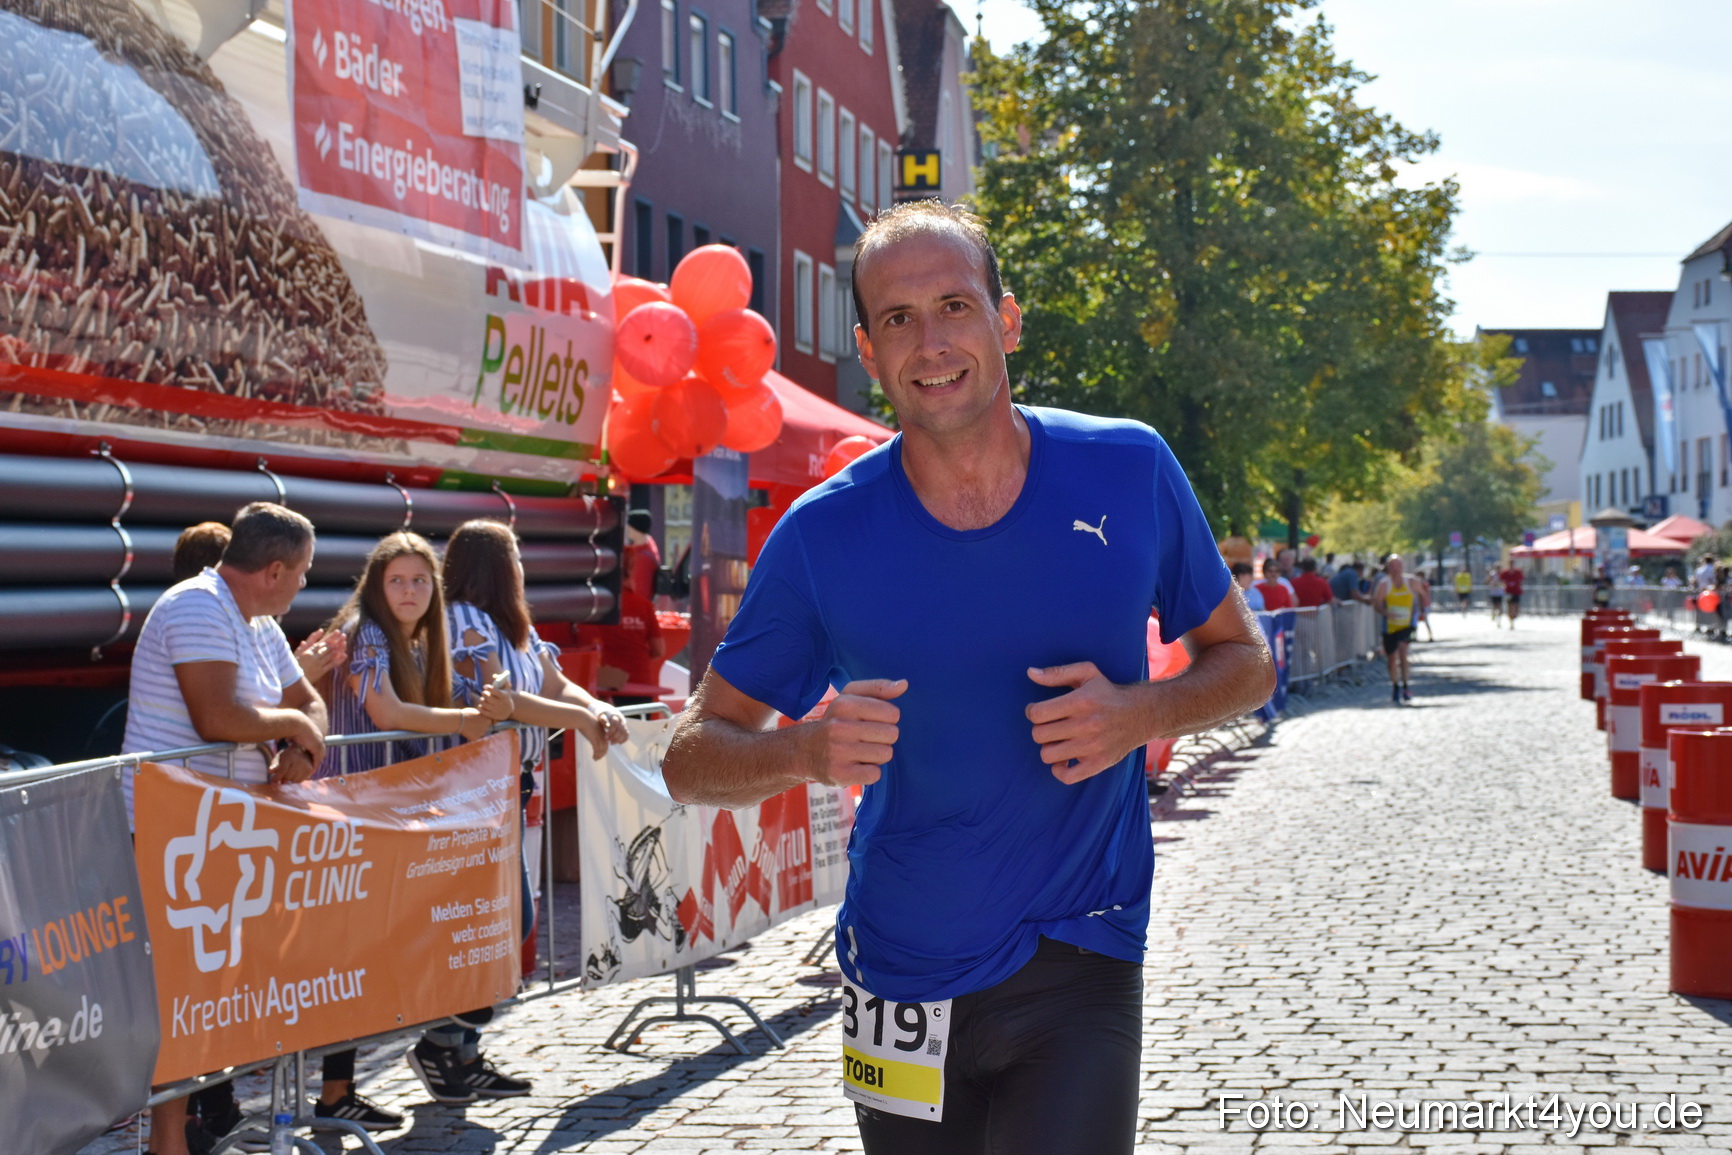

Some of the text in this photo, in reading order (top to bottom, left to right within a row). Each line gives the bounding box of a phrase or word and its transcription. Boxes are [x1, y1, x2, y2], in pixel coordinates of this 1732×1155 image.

[334, 31, 403, 97] Bäder
[338, 121, 510, 234] Energieberatung
[903, 153, 939, 187] H
[471, 314, 589, 426] Pellets
[290, 820, 364, 865] CODE
[466, 848, 486, 868] und
[284, 861, 373, 911] CLINIC
[32, 895, 136, 975] LOUNGE
[431, 901, 474, 923] Melden
[172, 967, 366, 1038] KreativAgentur
[844, 986, 928, 1052] 319
[933, 1007, 942, 1018] C
[845, 1055, 884, 1088] TOBI
